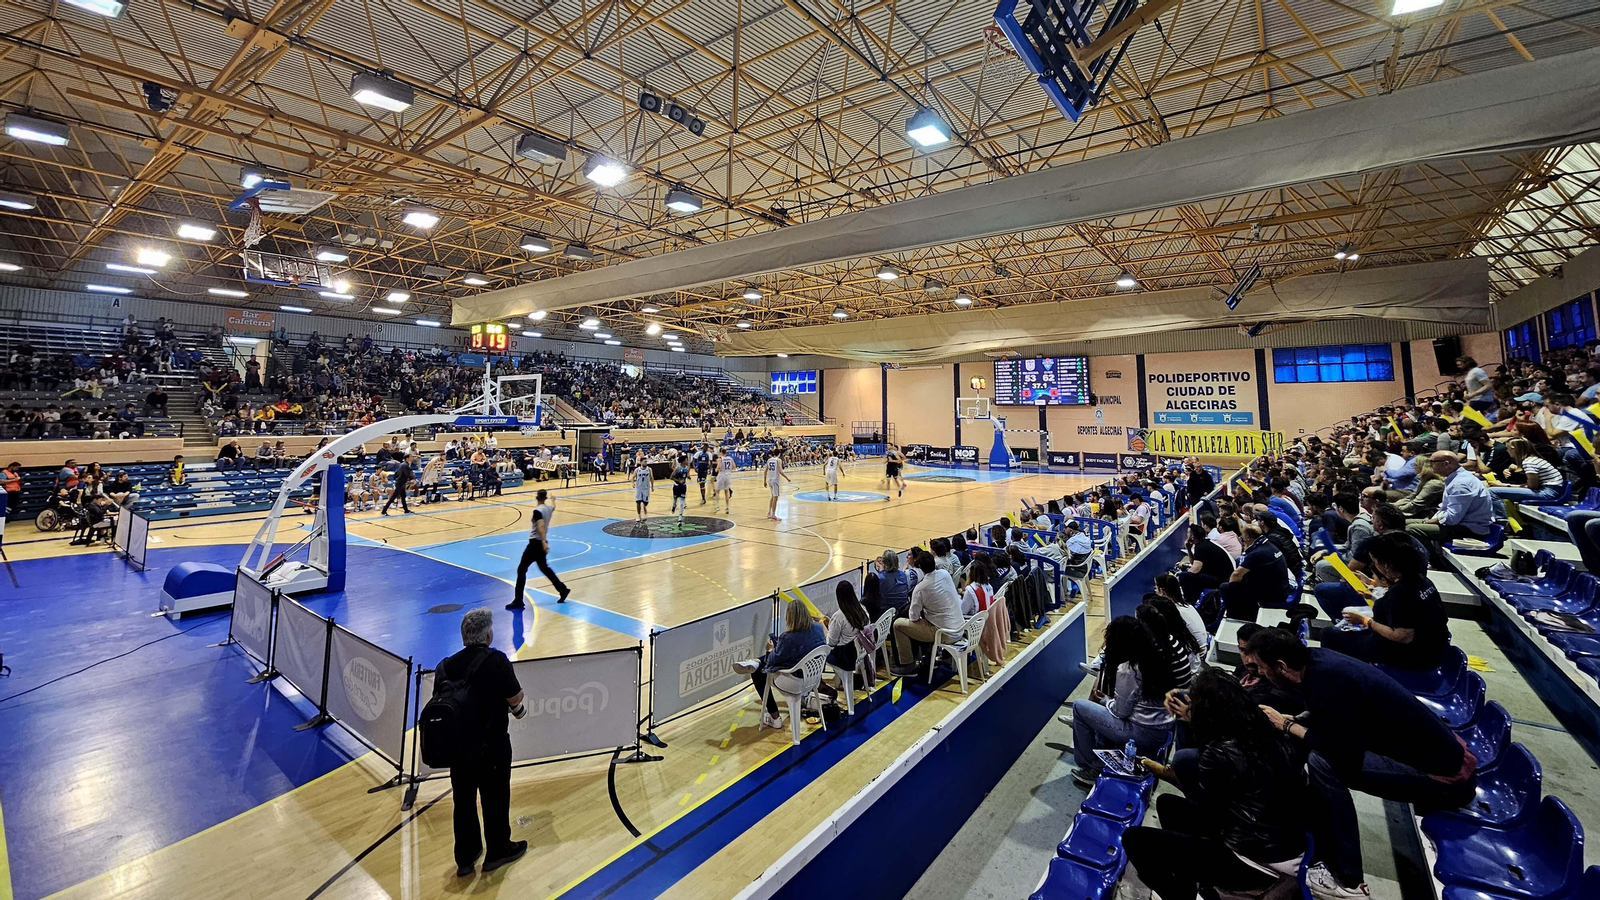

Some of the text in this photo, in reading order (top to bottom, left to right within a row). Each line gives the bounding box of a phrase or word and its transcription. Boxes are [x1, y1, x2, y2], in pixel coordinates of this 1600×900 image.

[113, 298, 120, 308] A
[242, 310, 260, 319] Bar
[489, 333, 507, 349] 19
[1024, 374, 1037, 382] 53
[1042, 374, 1055, 382] 62
[1149, 371, 1251, 383] POLIDEPORTIVO
[1166, 385, 1236, 397] CIUDAD DE
[1100, 395, 1122, 405] MUNICIPAL
[1165, 399, 1237, 410] ALGECIRAS
[1077, 425, 1122, 436] DEPORTES ALGECIRAS
[1153, 430, 1166, 452] LA
[1170, 430, 1230, 454] FORTALEZA
[723, 461, 731, 470] 12
[768, 461, 776, 471] 55
